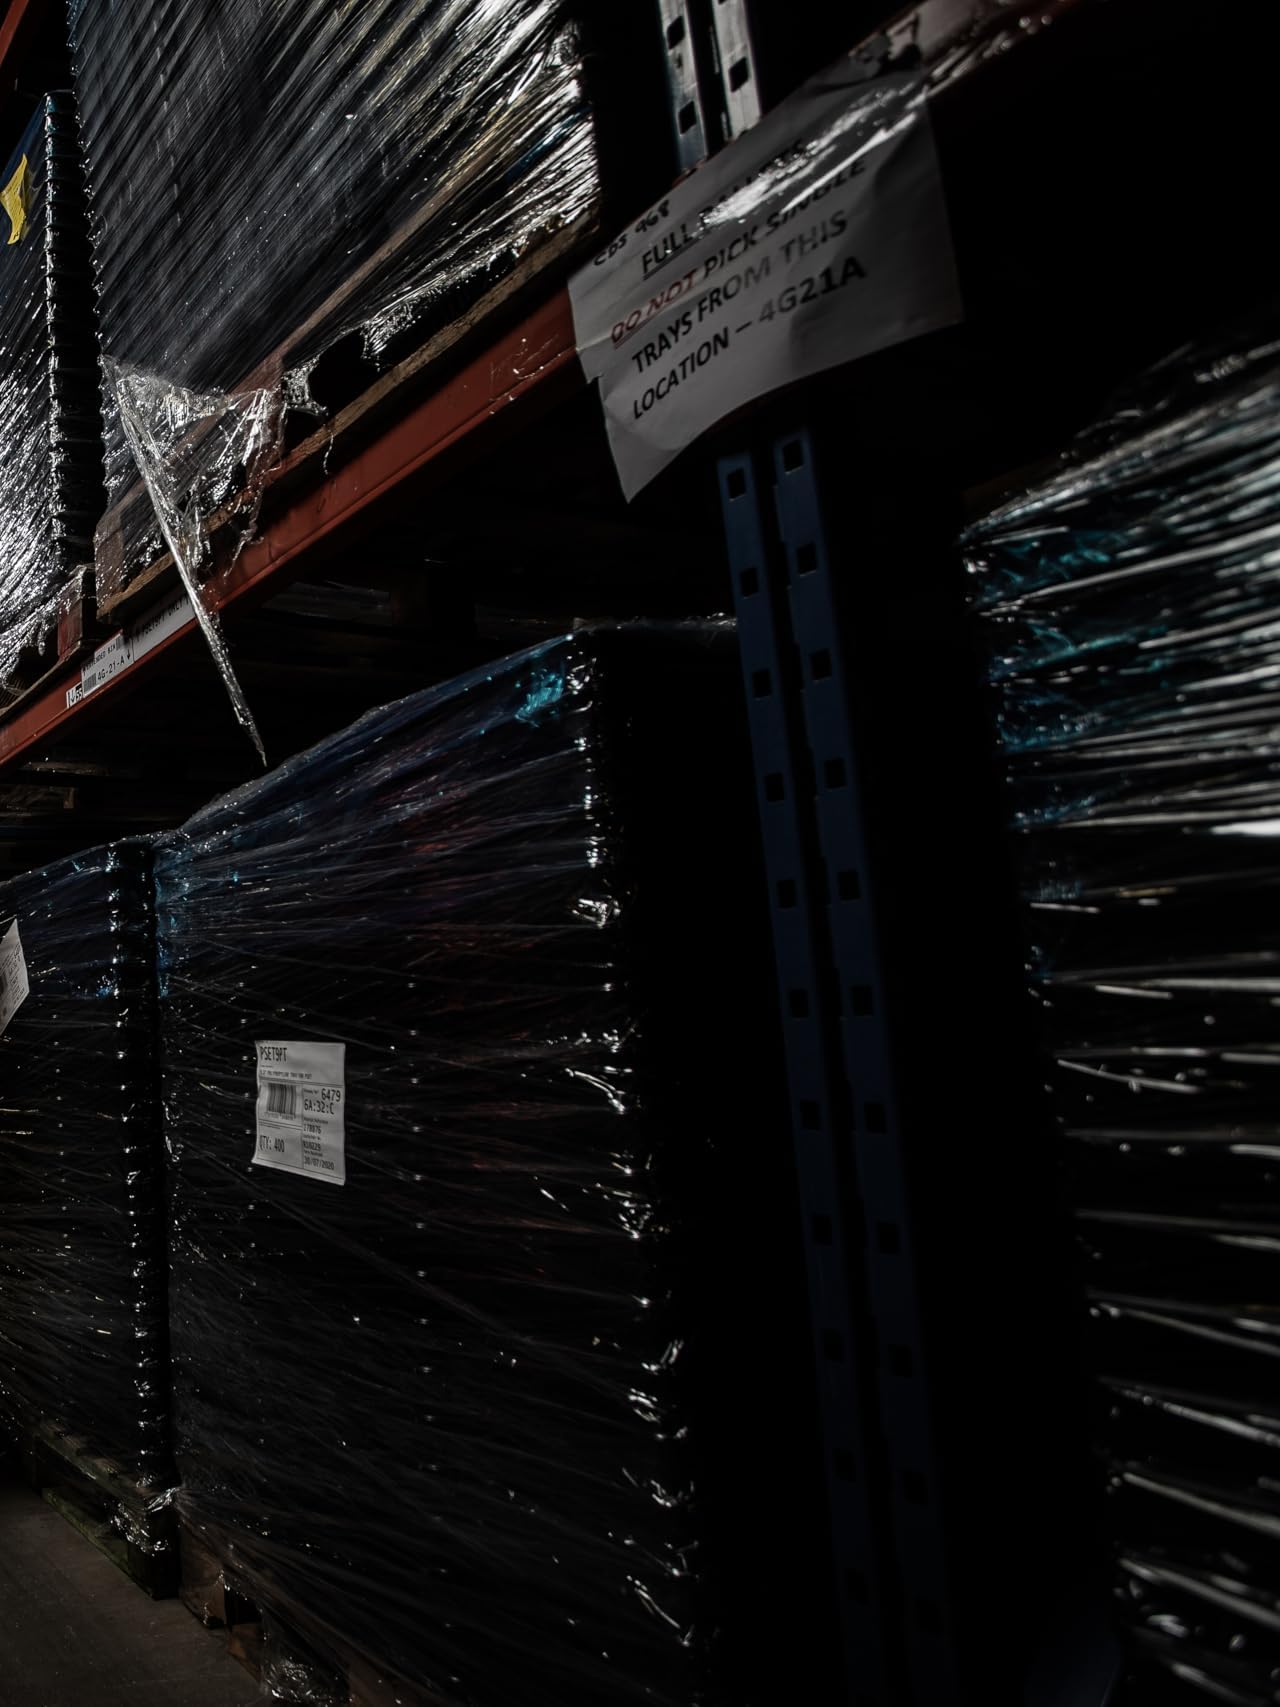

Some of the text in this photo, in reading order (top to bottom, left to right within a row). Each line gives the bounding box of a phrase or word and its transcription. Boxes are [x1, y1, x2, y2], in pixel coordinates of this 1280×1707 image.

[611, 309, 642, 344] DO
[647, 267, 698, 317] NOT
[704, 224, 759, 279] PICK
[631, 209, 848, 373] TRAYS FROM THIS
[642, 223, 695, 275] FULL
[633, 326, 730, 420] LOCATION
[758, 256, 868, 323] 4G21A
[321, 1088, 341, 1103] 6479
